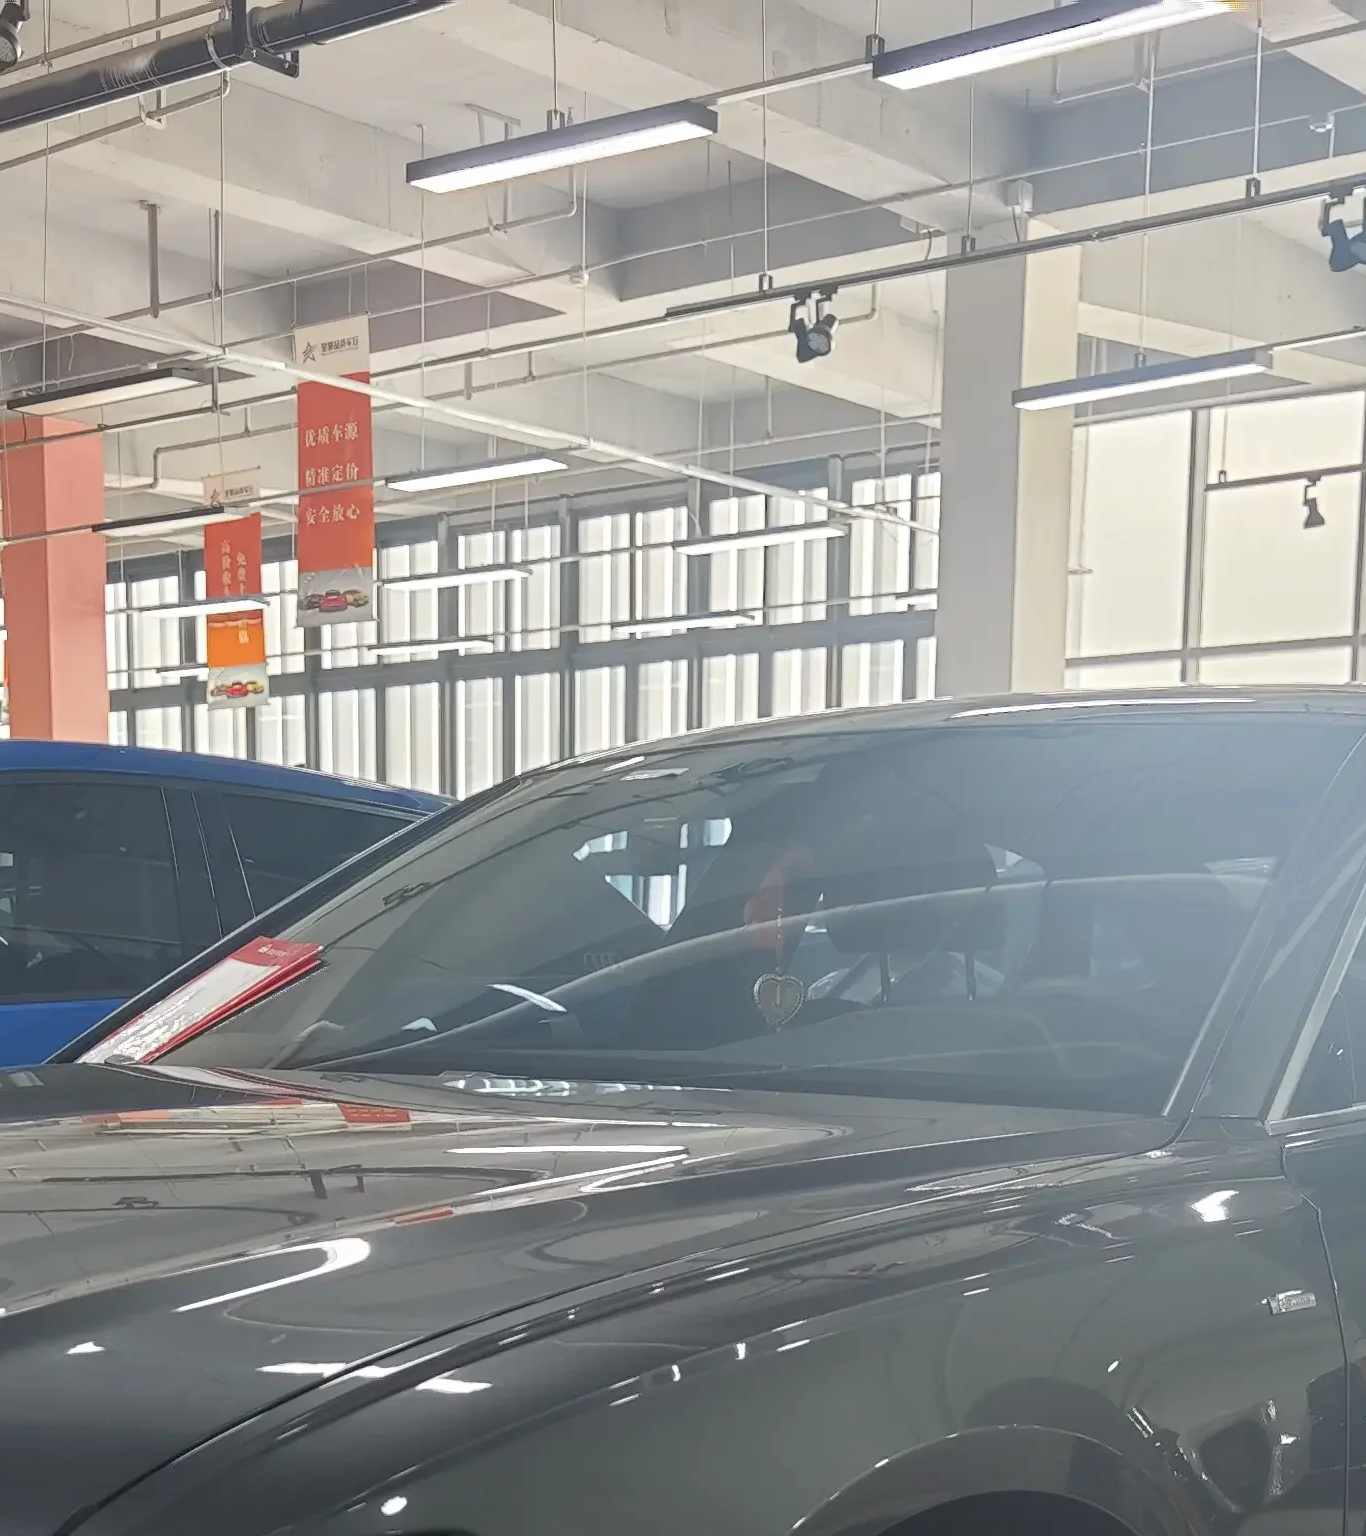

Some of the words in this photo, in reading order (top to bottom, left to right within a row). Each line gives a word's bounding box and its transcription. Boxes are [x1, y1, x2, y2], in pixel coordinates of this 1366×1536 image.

[305, 420, 359, 448] 优质车源
[305, 462, 360, 488] 精准定价
[306, 503, 361, 526] 安全放心
